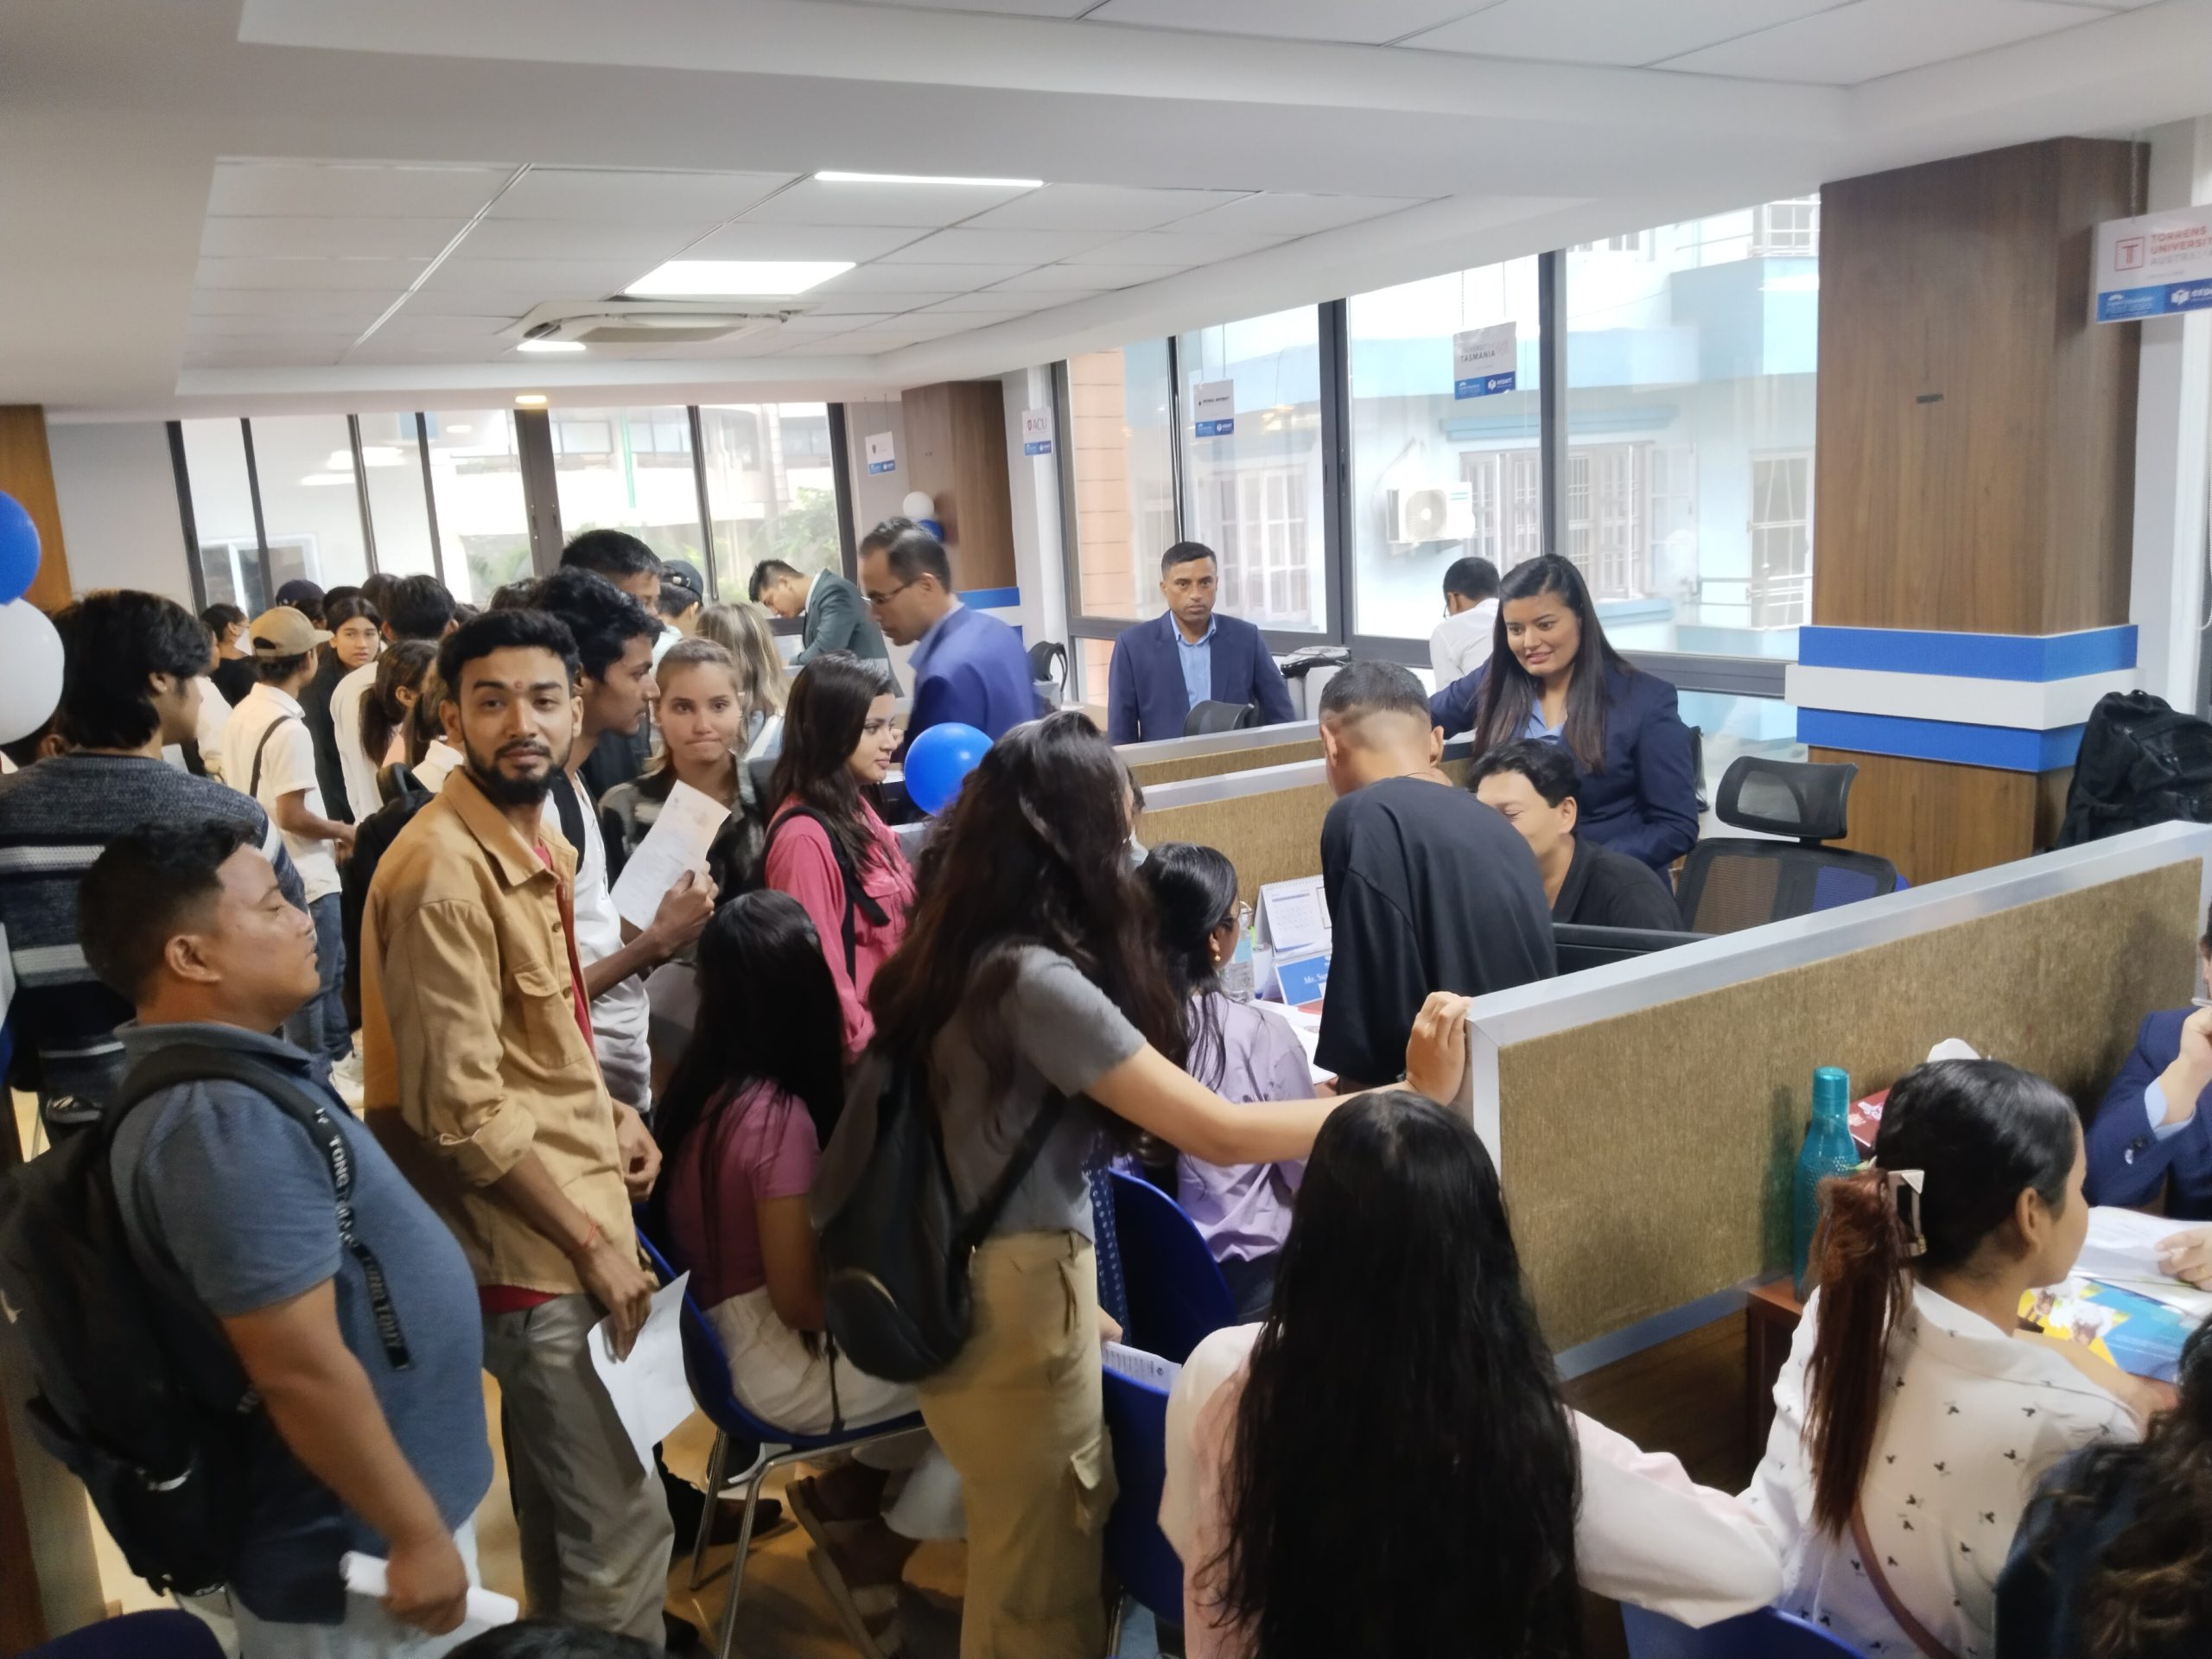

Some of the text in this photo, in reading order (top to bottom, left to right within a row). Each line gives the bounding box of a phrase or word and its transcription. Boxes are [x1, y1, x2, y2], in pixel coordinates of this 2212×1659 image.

[2151, 226, 2207, 242] TORRENS
[1460, 350, 1495, 362] TASMANIA
[1033, 417, 1047, 430] ACU
